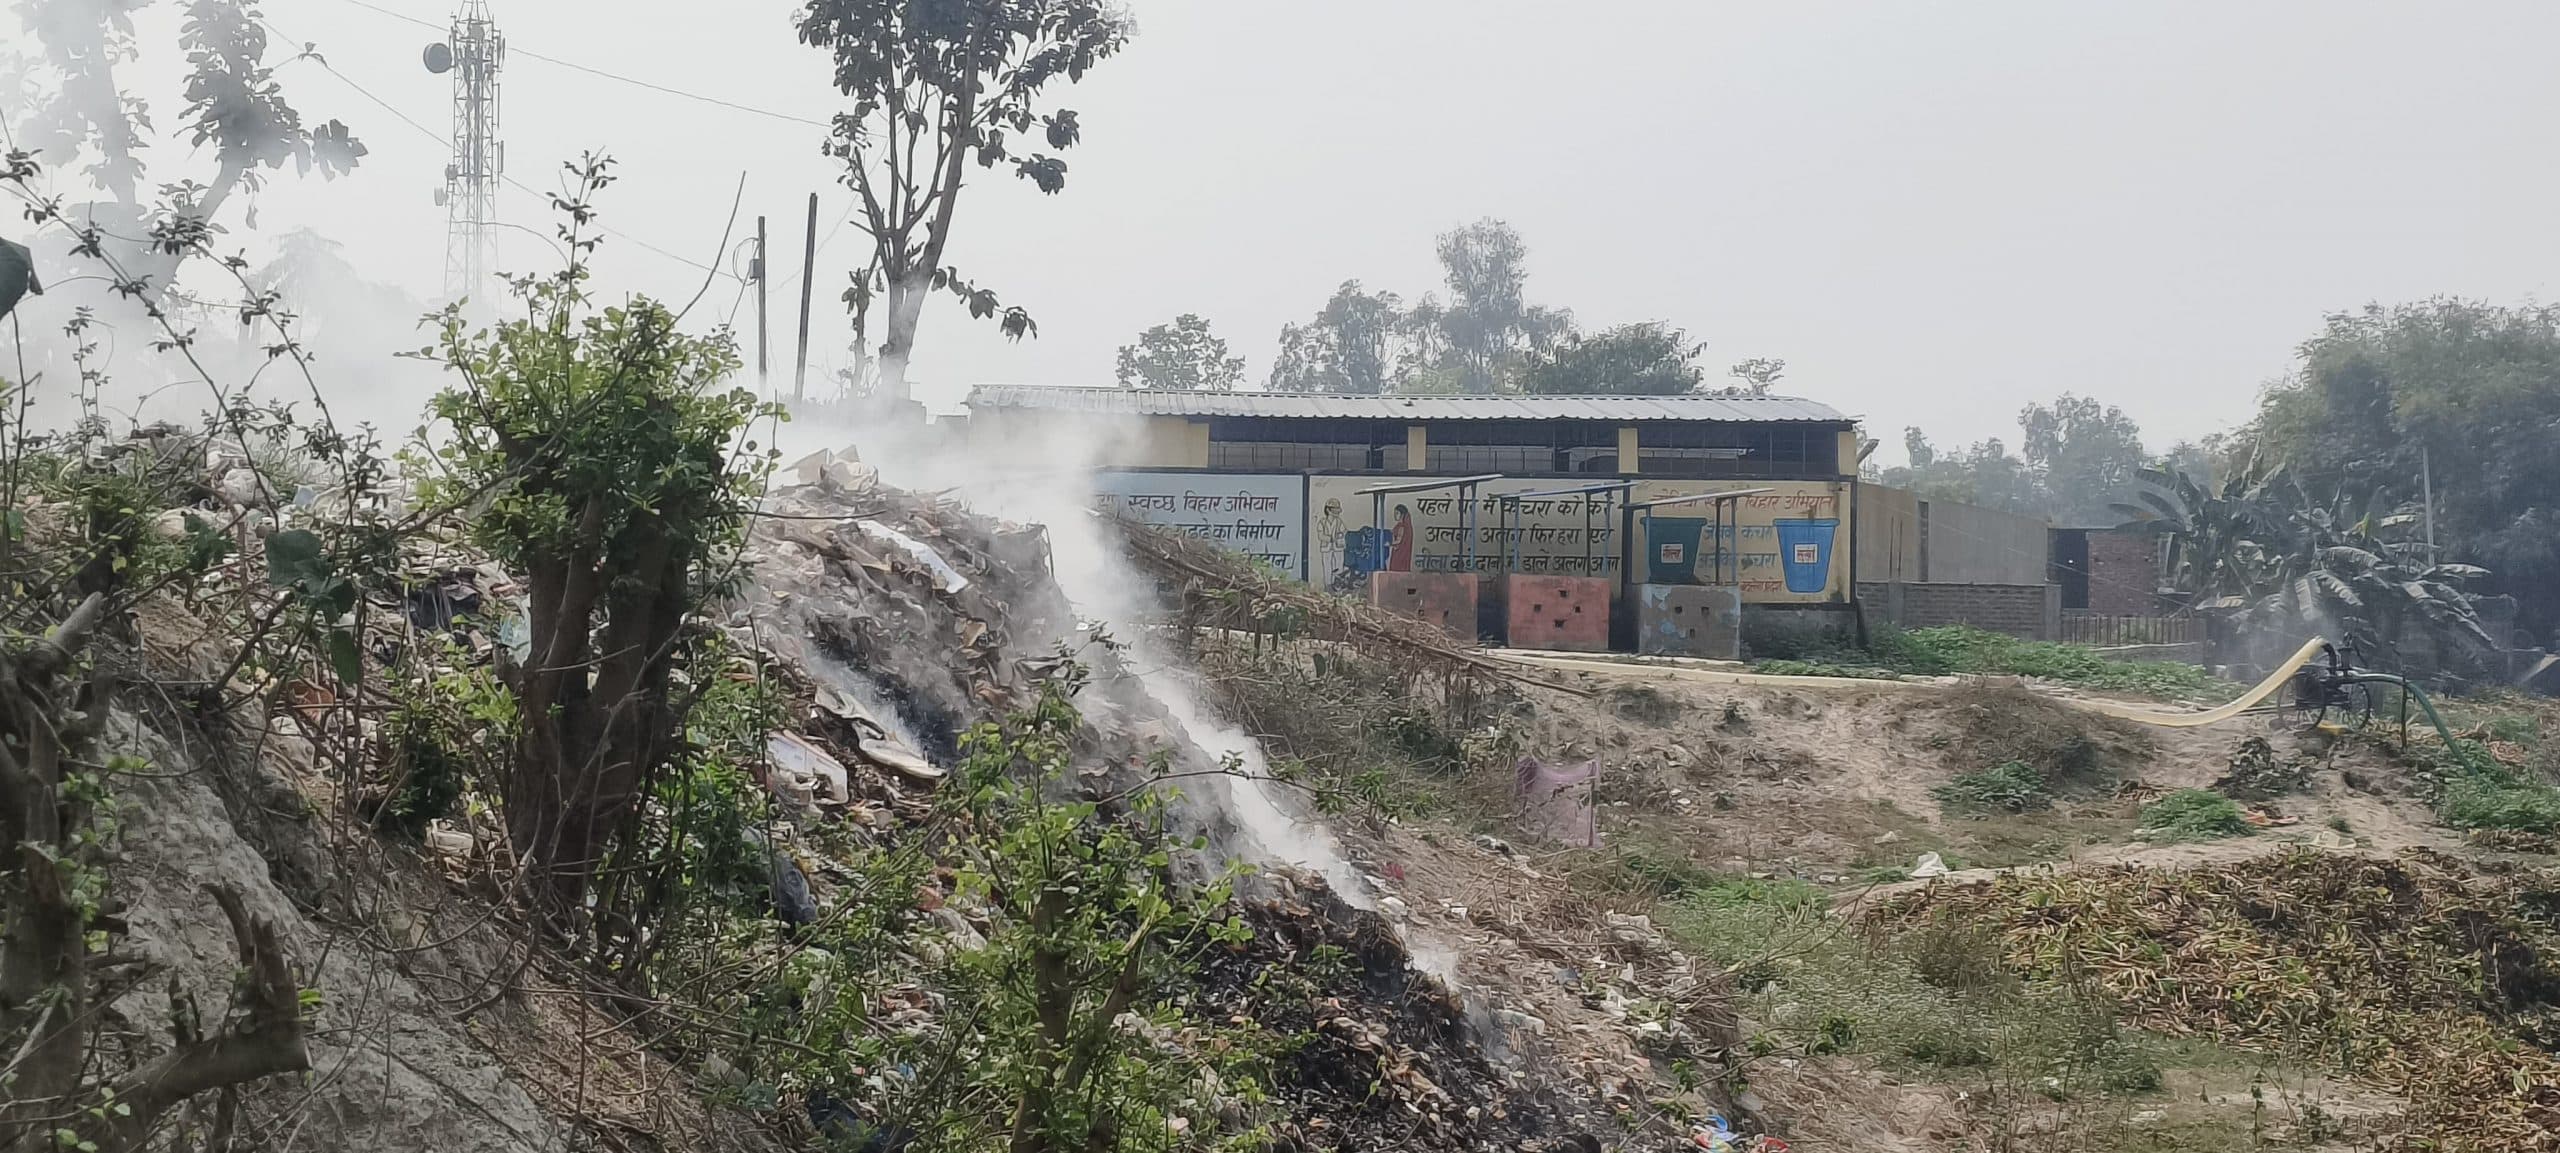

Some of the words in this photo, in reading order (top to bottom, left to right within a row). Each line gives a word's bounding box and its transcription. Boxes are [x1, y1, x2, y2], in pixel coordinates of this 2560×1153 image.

[1225, 490, 1280, 512] अभियान
[1416, 492, 1453, 516] पहले
[1558, 495, 1585, 516] को
[1784, 490, 1834, 510] अभियान
[1213, 524, 1234, 541] का
[1235, 519, 1285, 540] निर्माण
[1529, 523, 1557, 544] फिर
[1558, 528, 1581, 546] हरा
[1415, 547, 1448, 568] नीला
[1553, 556, 1588, 571] अलग
